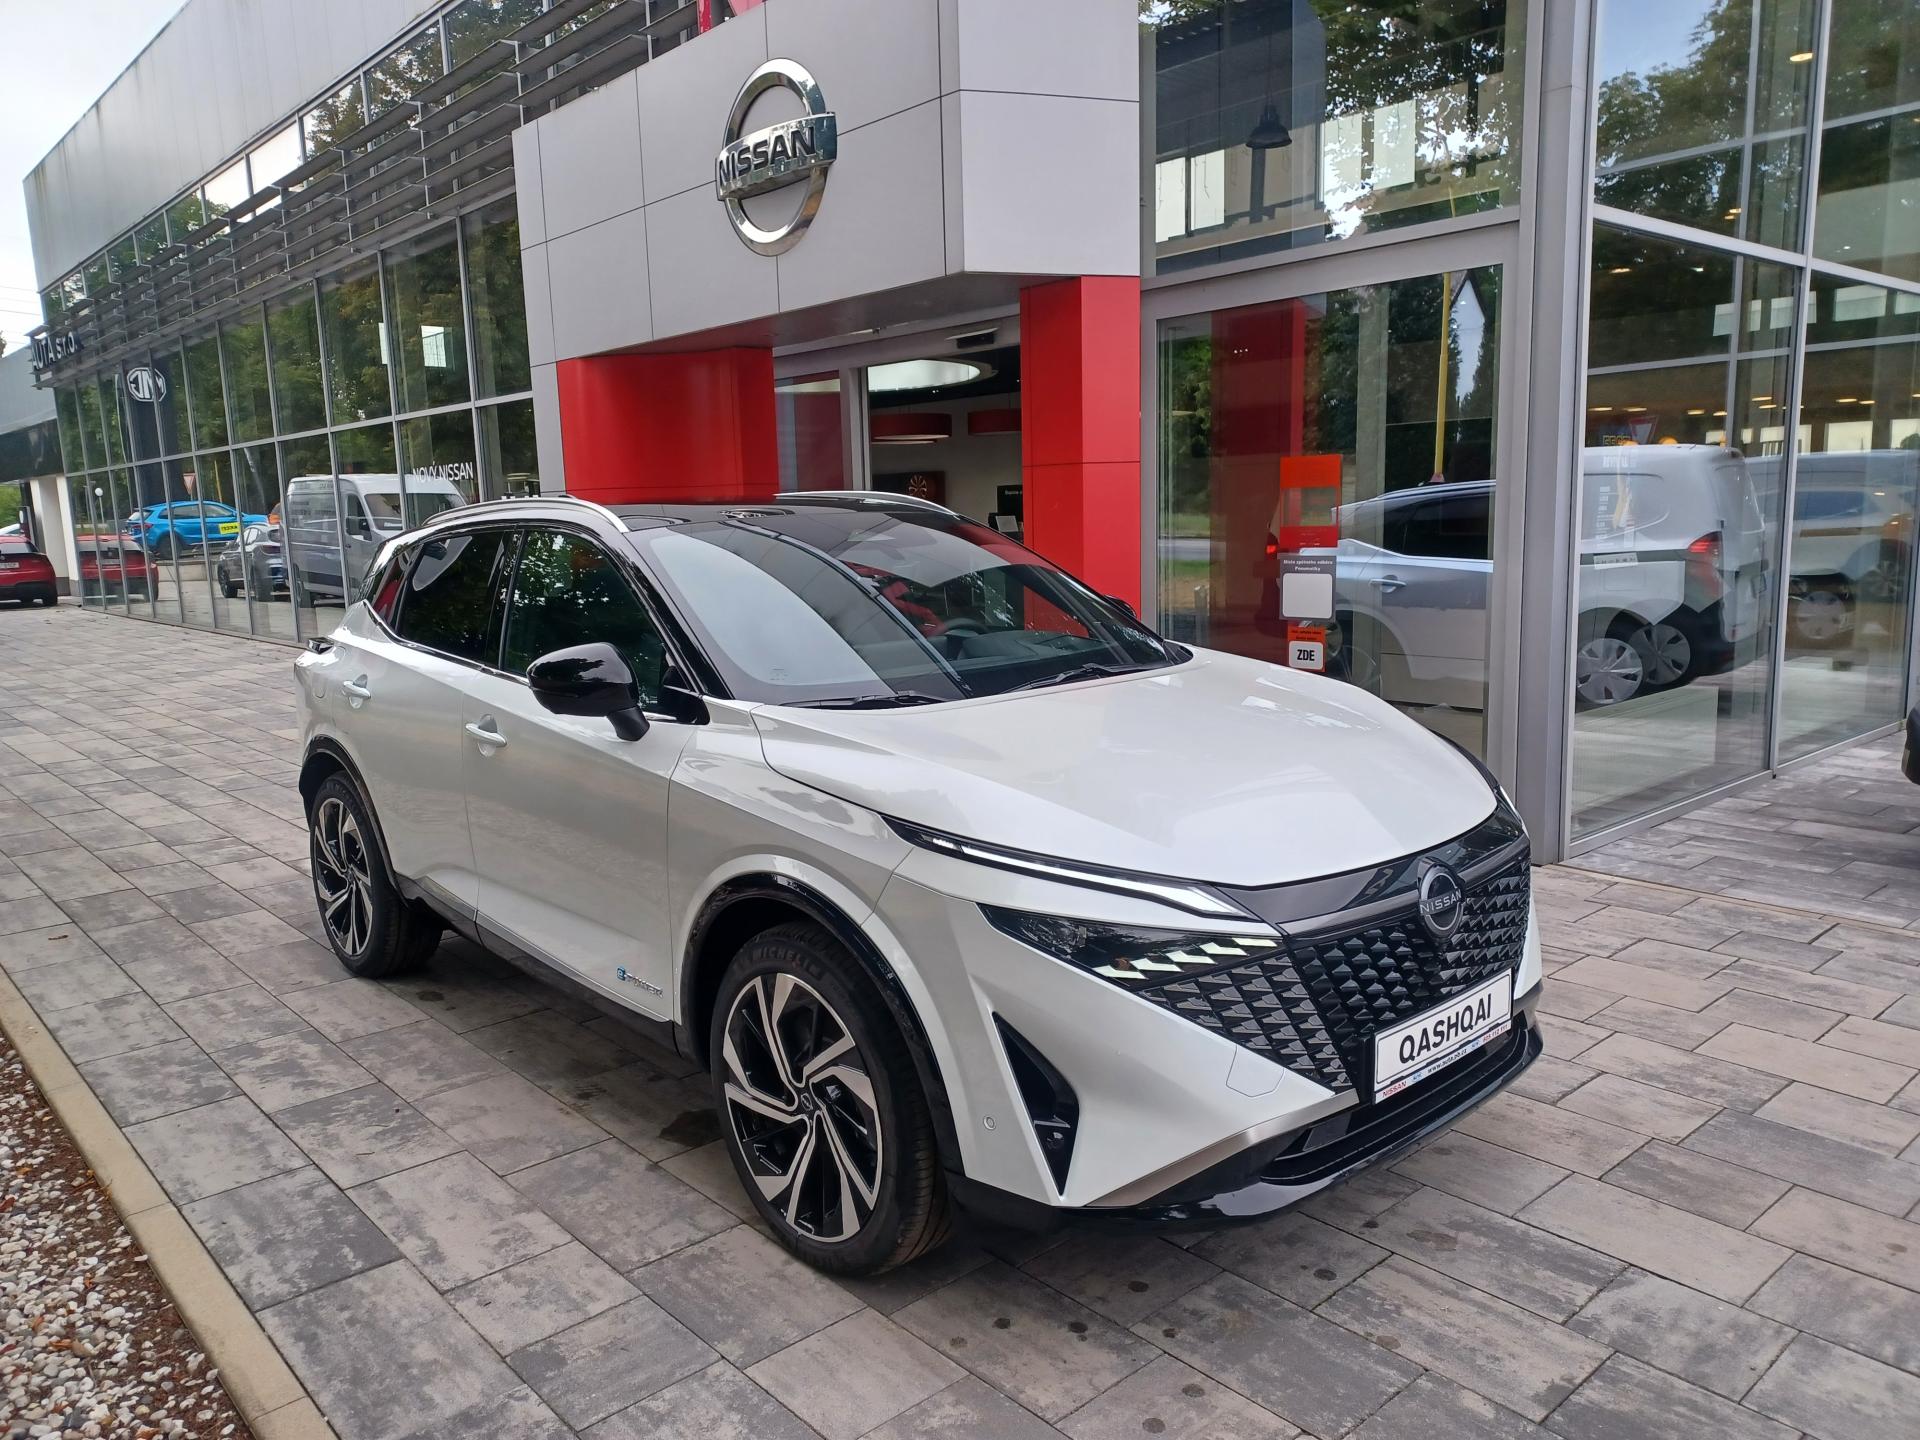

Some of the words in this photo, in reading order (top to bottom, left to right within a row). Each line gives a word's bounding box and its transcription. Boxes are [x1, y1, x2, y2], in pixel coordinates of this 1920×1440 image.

[719, 126, 816, 188] NISSAN
[412, 461, 437, 483] NOVÝ
[439, 461, 474, 481] NISSAN
[1297, 649, 1315, 661] ZDE
[1420, 889, 1461, 914] NISSAN
[1399, 993, 1491, 1064] QASHQAI
[1381, 1080, 1407, 1098] NISSAN
